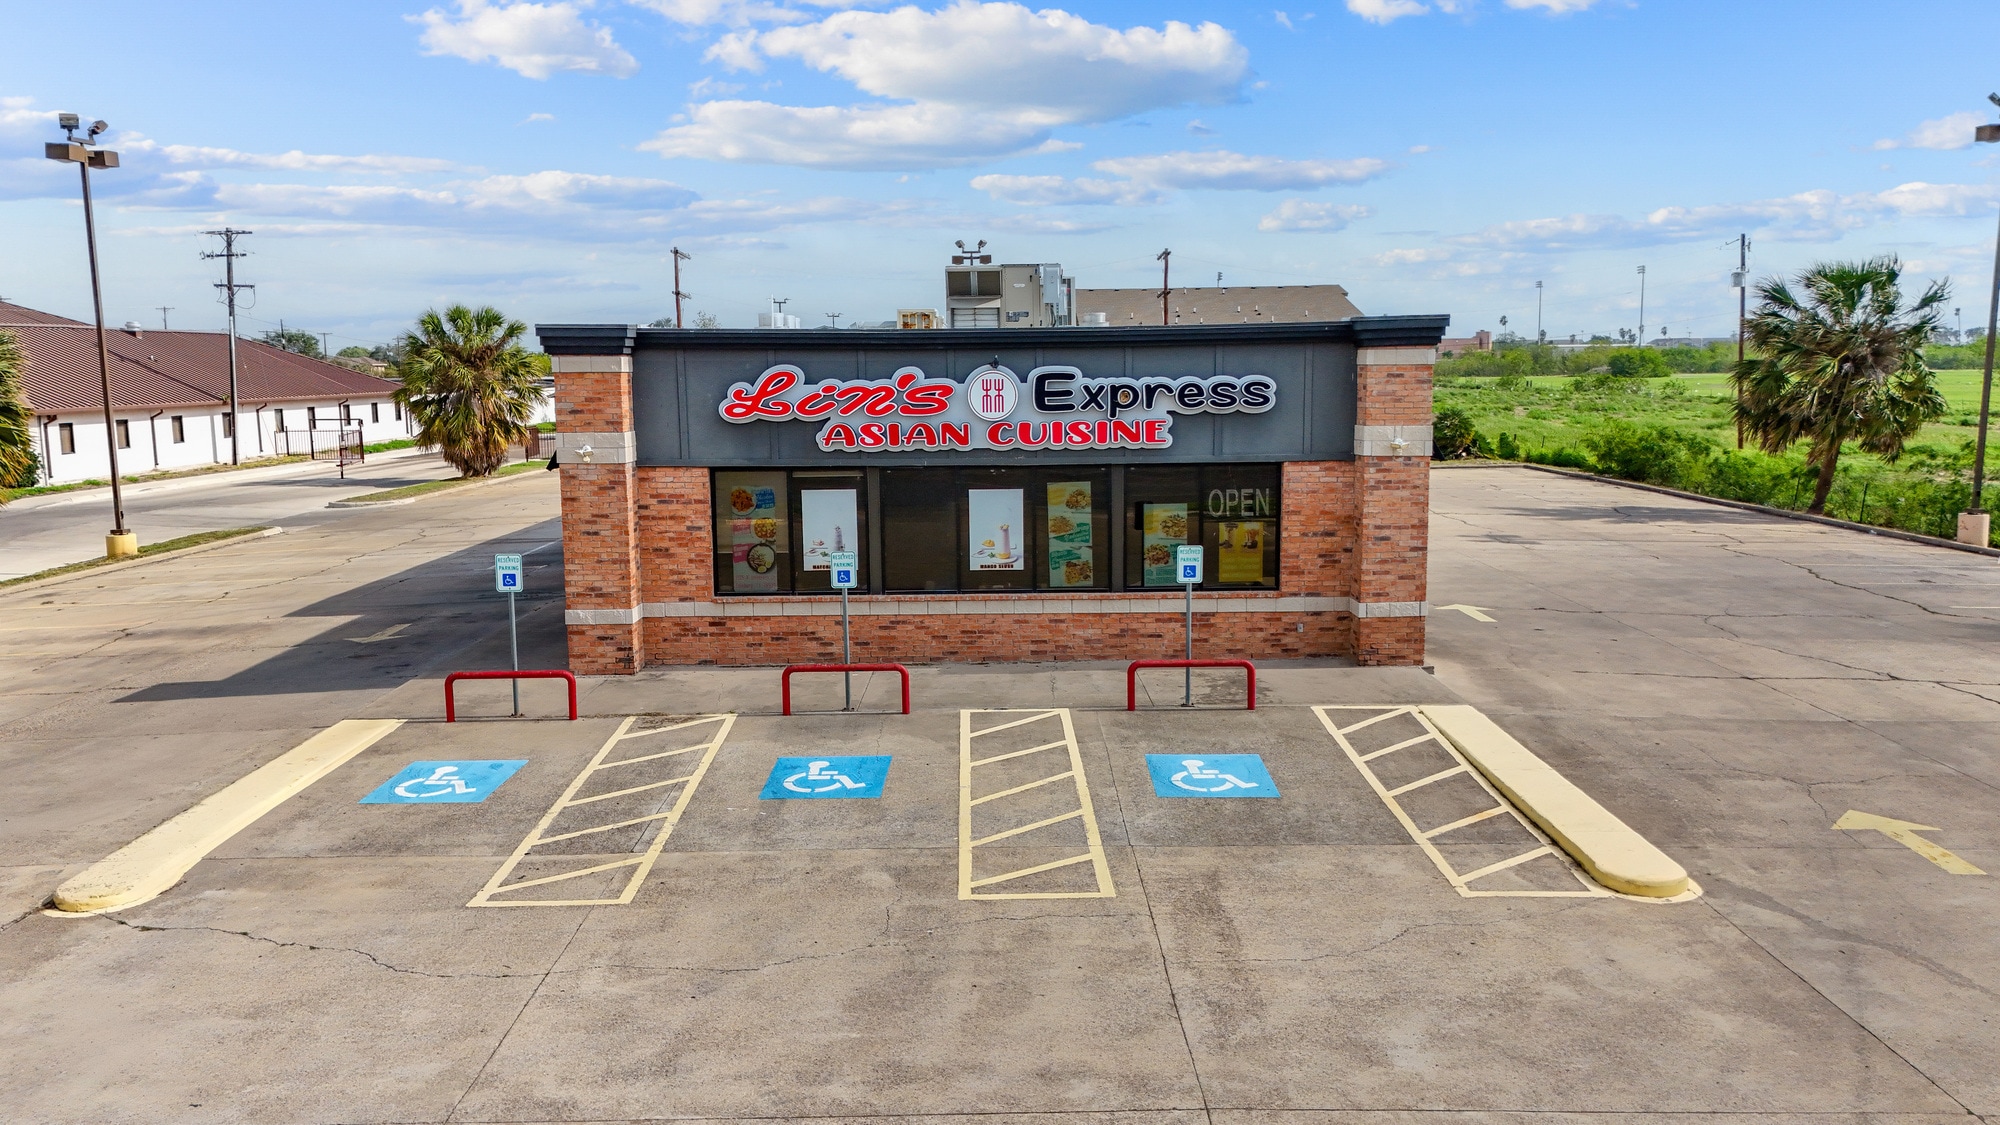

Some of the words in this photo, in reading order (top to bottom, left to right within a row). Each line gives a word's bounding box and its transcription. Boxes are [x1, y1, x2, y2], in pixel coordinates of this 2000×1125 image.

[723, 370, 955, 419] Lin's
[1033, 371, 1276, 419] Express
[821, 422, 971, 448] ASIAN
[986, 419, 1168, 446] CUISINE
[1208, 488, 1270, 518] OPEN
